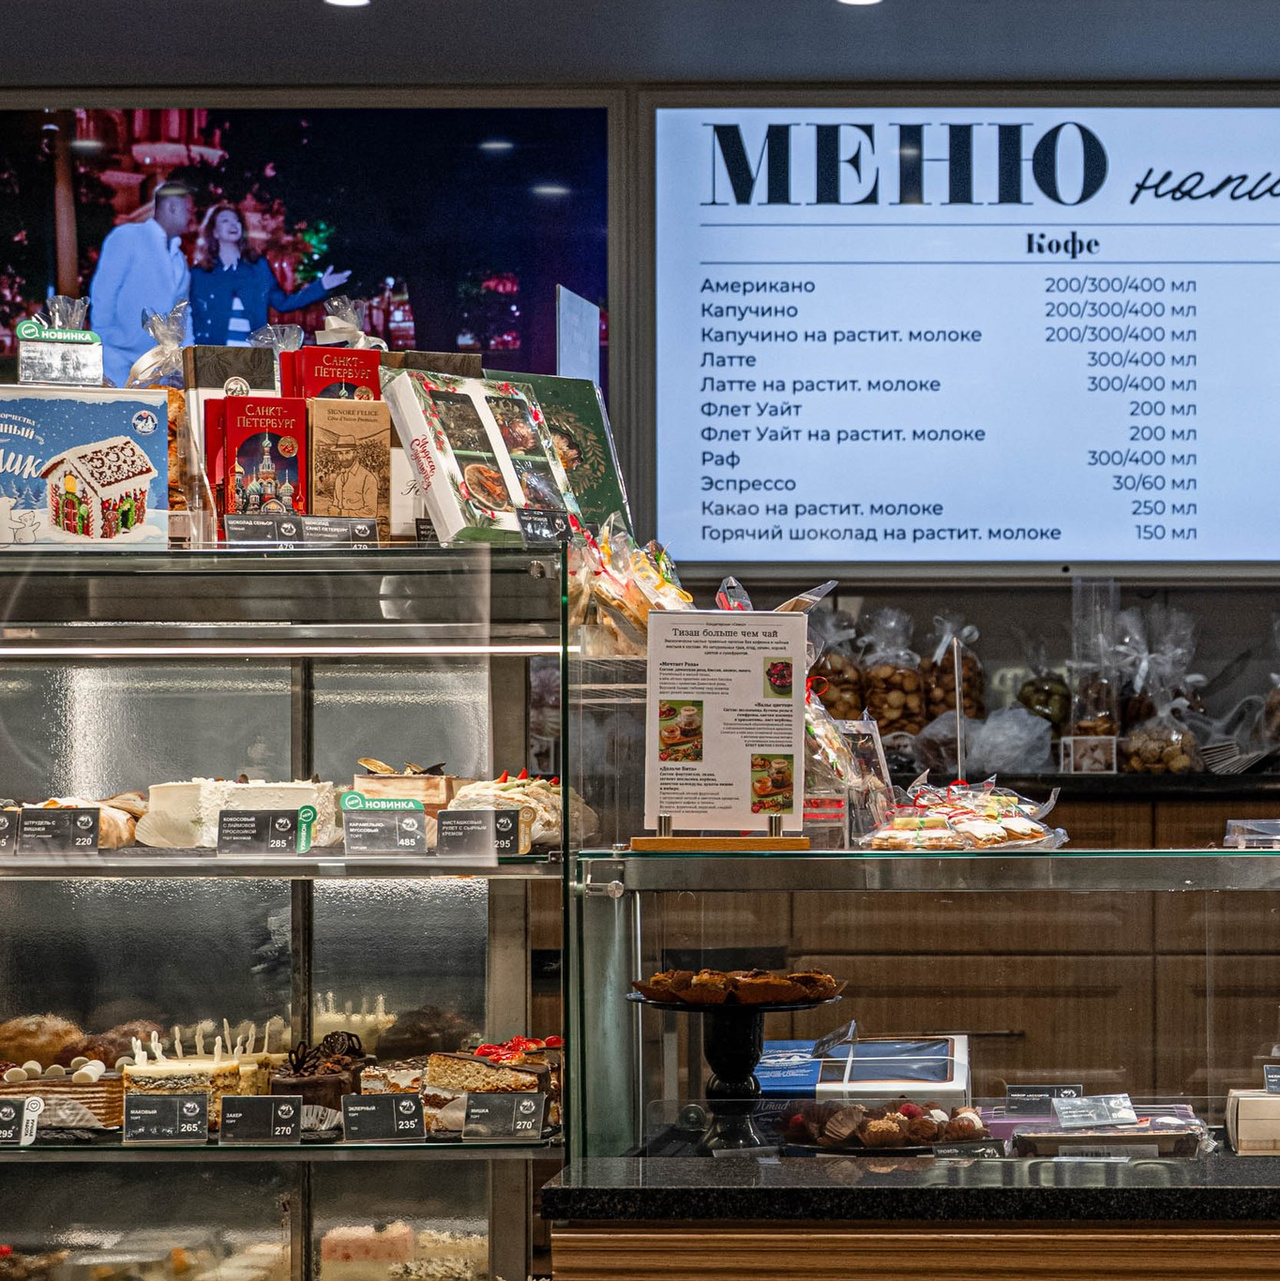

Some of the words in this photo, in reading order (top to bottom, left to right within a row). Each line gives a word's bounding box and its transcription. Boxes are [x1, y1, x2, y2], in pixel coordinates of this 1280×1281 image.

[700, 121, 1108, 206] МЕНЮ
[1026, 232, 1100, 259] Кофе
[699, 278, 815, 296] Американо
[1045, 276, 1165, 293] 200/300/400
[1171, 281, 1196, 292] мл
[701, 303, 798, 321] Капучино
[1045, 301, 1165, 318] 200/300/400
[1171, 306, 1196, 317] мл
[41, 330, 92, 341] НОВИНКА
[701, 327, 798, 346] Капучино
[804, 331, 826, 342] на
[833, 331, 902, 344] растит.
[908, 331, 982, 341] молоке
[1045, 325, 1165, 342] 200/300/400
[1171, 330, 1196, 341] мл
[699, 352, 756, 367] Латте
[1087, 350, 1165, 367] 300/400
[1171, 355, 1196, 366] мл
[699, 377, 756, 392] Латте
[762, 380, 785, 391] на
[792, 380, 861, 394] растит.
[867, 380, 940, 391] молоке
[1087, 375, 1165, 392] 300/400
[1171, 380, 1196, 391] мл
[327, 408, 355, 416] SIGNORE
[700, 402, 751, 416] Флет
[756, 402, 801, 416] Уайт
[1129, 401, 1165, 416] 200
[1171, 405, 1196, 415] мл
[700, 427, 750, 441] Флет
[756, 427, 801, 441] Уайт
[807, 430, 830, 441] на
[837, 430, 905, 444] растит.
[912, 430, 985, 441] молоке
[1129, 426, 1165, 441] 200
[1171, 429, 1196, 440] мл
[701, 451, 740, 469] Раф
[1087, 449, 1165, 466] 300/400
[1171, 454, 1196, 465] мл
[700, 476, 796, 494] Эспрессо
[1112, 474, 1165, 491] 30/60
[1171, 479, 1196, 490] мл
[701, 501, 759, 515] Какао
[765, 504, 788, 515] на
[794, 504, 863, 518] растит.
[869, 504, 943, 515] молоке
[1131, 500, 1165, 515] 250
[1171, 504, 1196, 514] мл
[701, 525, 782, 543] Горячий
[789, 529, 878, 541] шоколад
[883, 529, 906, 540] на
[912, 528, 981, 543] растит.
[988, 528, 1061, 540] молоке
[1135, 525, 1165, 539] 150
[1171, 528, 1196, 539] мл
[672, 628, 700, 637] Тизан
[702, 628, 738, 637] больше
[741, 630, 759, 638] чем
[762, 630, 778, 638] чай
[365, 800, 415, 809] НОВИНКА
[75, 837, 92, 846] 220
[270, 839, 287, 848] 285
[398, 838, 415, 846] 485
[494, 839, 511, 848] 295
[180, 1123, 198, 1132] 265
[275, 1126, 292, 1135] 270
[398, 1121, 416, 1129] 235
[516, 1121, 532, 1130] 270
